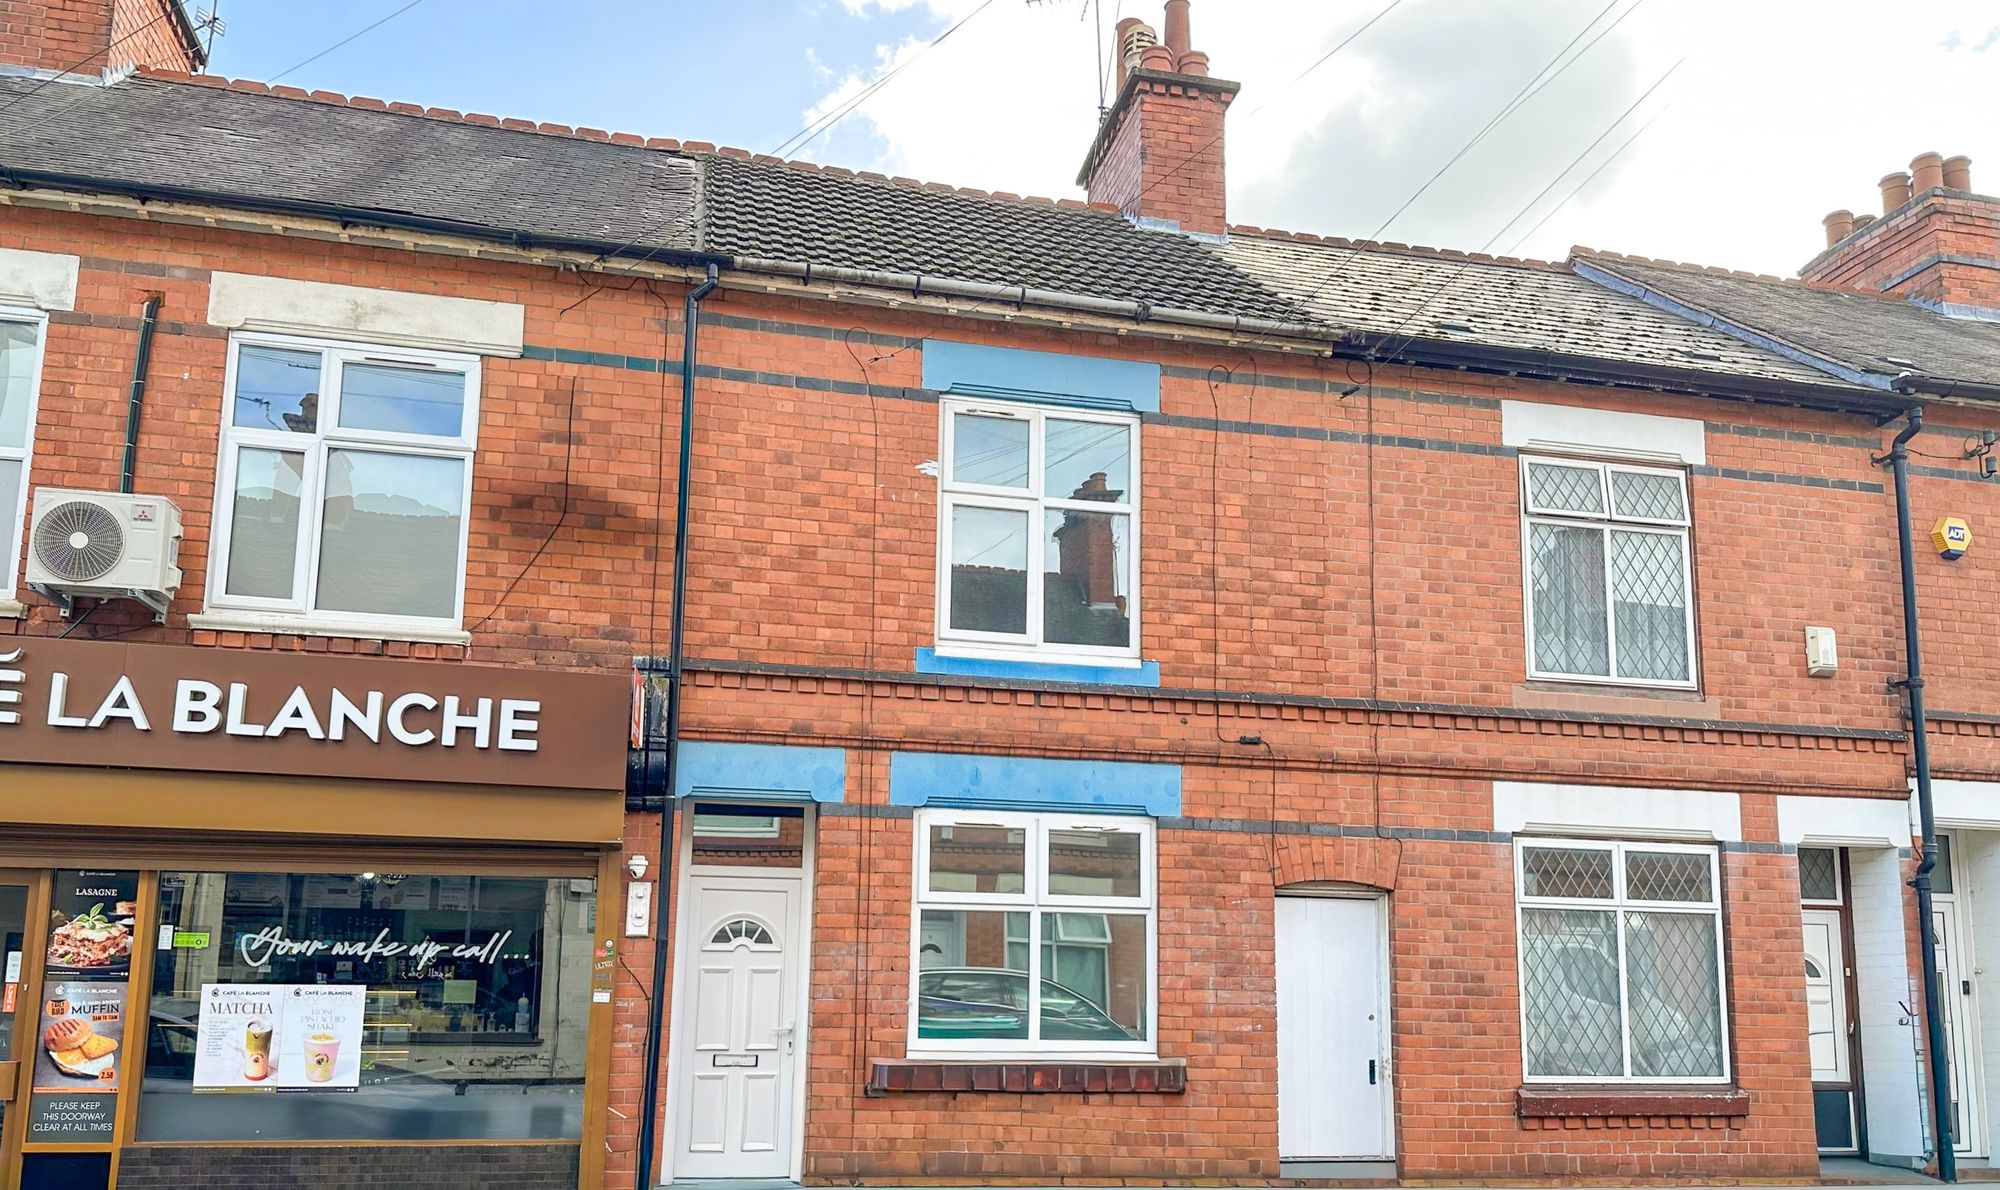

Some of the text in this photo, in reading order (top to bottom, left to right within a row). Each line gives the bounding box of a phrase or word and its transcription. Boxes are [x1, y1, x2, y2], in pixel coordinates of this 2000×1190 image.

[1948, 528, 1965, 539] ADT
[48, 672, 151, 730] LA
[172, 679, 541, 751] BLANCHE
[75, 888, 118, 896] LASAGNE
[240, 926, 529, 970] Your wake up call...
[71, 1004, 120, 1014] MUFFIN
[209, 1002, 273, 1014] MATCHA
[101, 1071, 114, 1079] 2.50
[49, 1101, 101, 1110] PLEASE KEEP
[43, 1112, 106, 1120] THIS DOORWAY
[33, 1122, 113, 1131] CLEAR AT ALL TIMES
